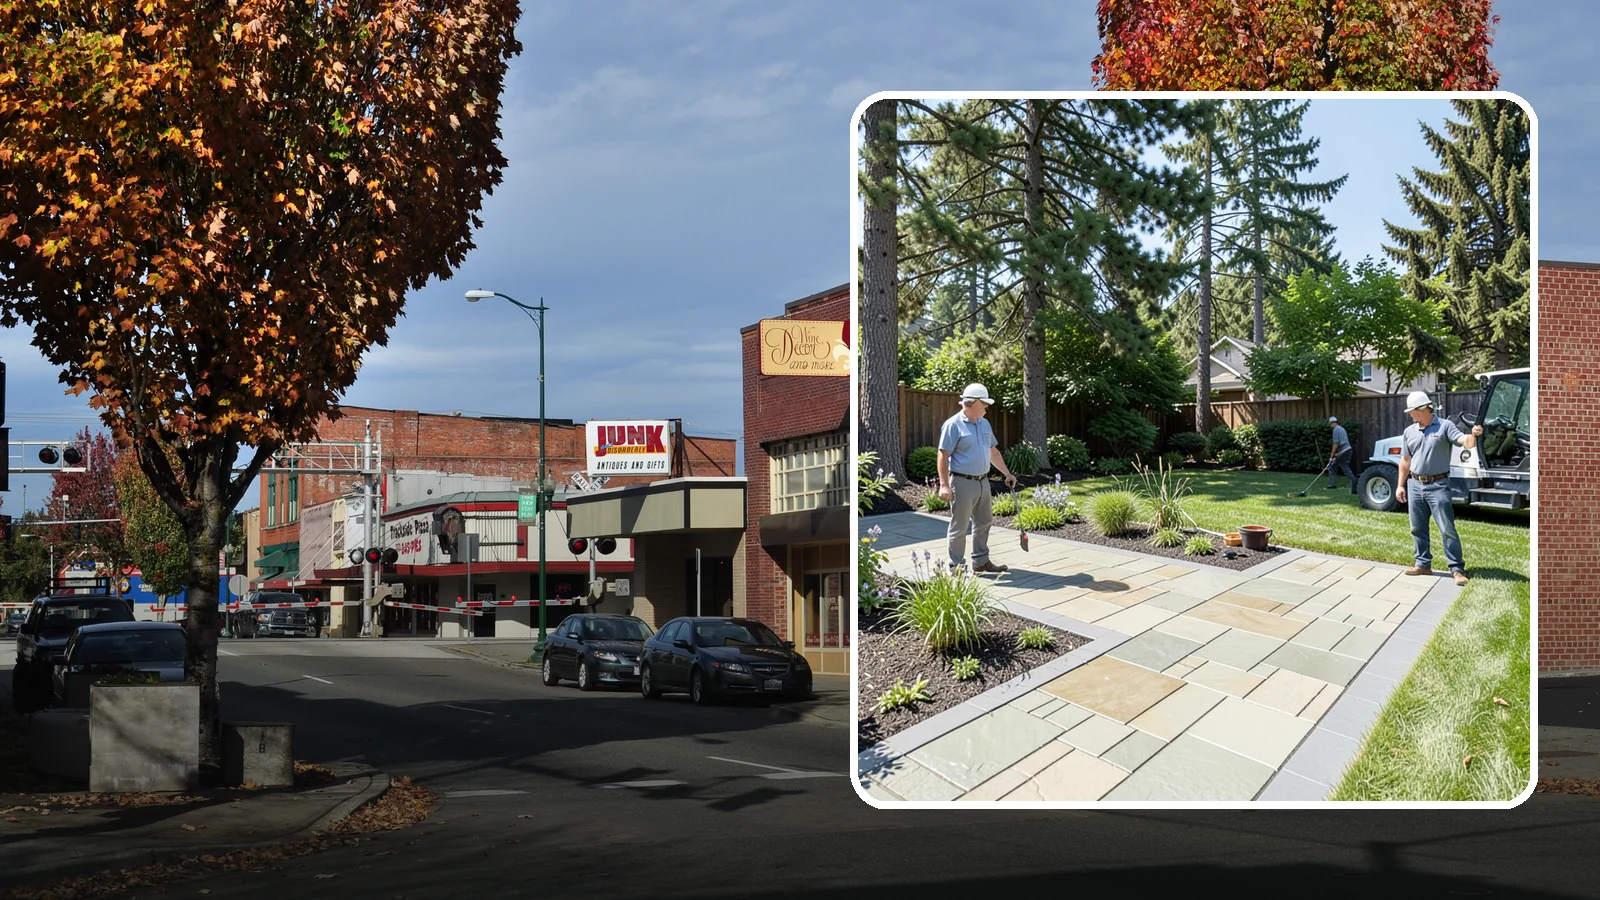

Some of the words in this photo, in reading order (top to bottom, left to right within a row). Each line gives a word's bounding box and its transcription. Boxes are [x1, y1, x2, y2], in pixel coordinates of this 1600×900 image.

[791, 325, 821, 345] Wine
[595, 425, 665, 457] JUNK
[607, 446, 646, 454] DISORDERLY
[597, 461, 628, 470] ANTIQUES
[631, 461, 644, 470] AND
[647, 460, 665, 469] GIFTS
[414, 519, 429, 535] Pizza
